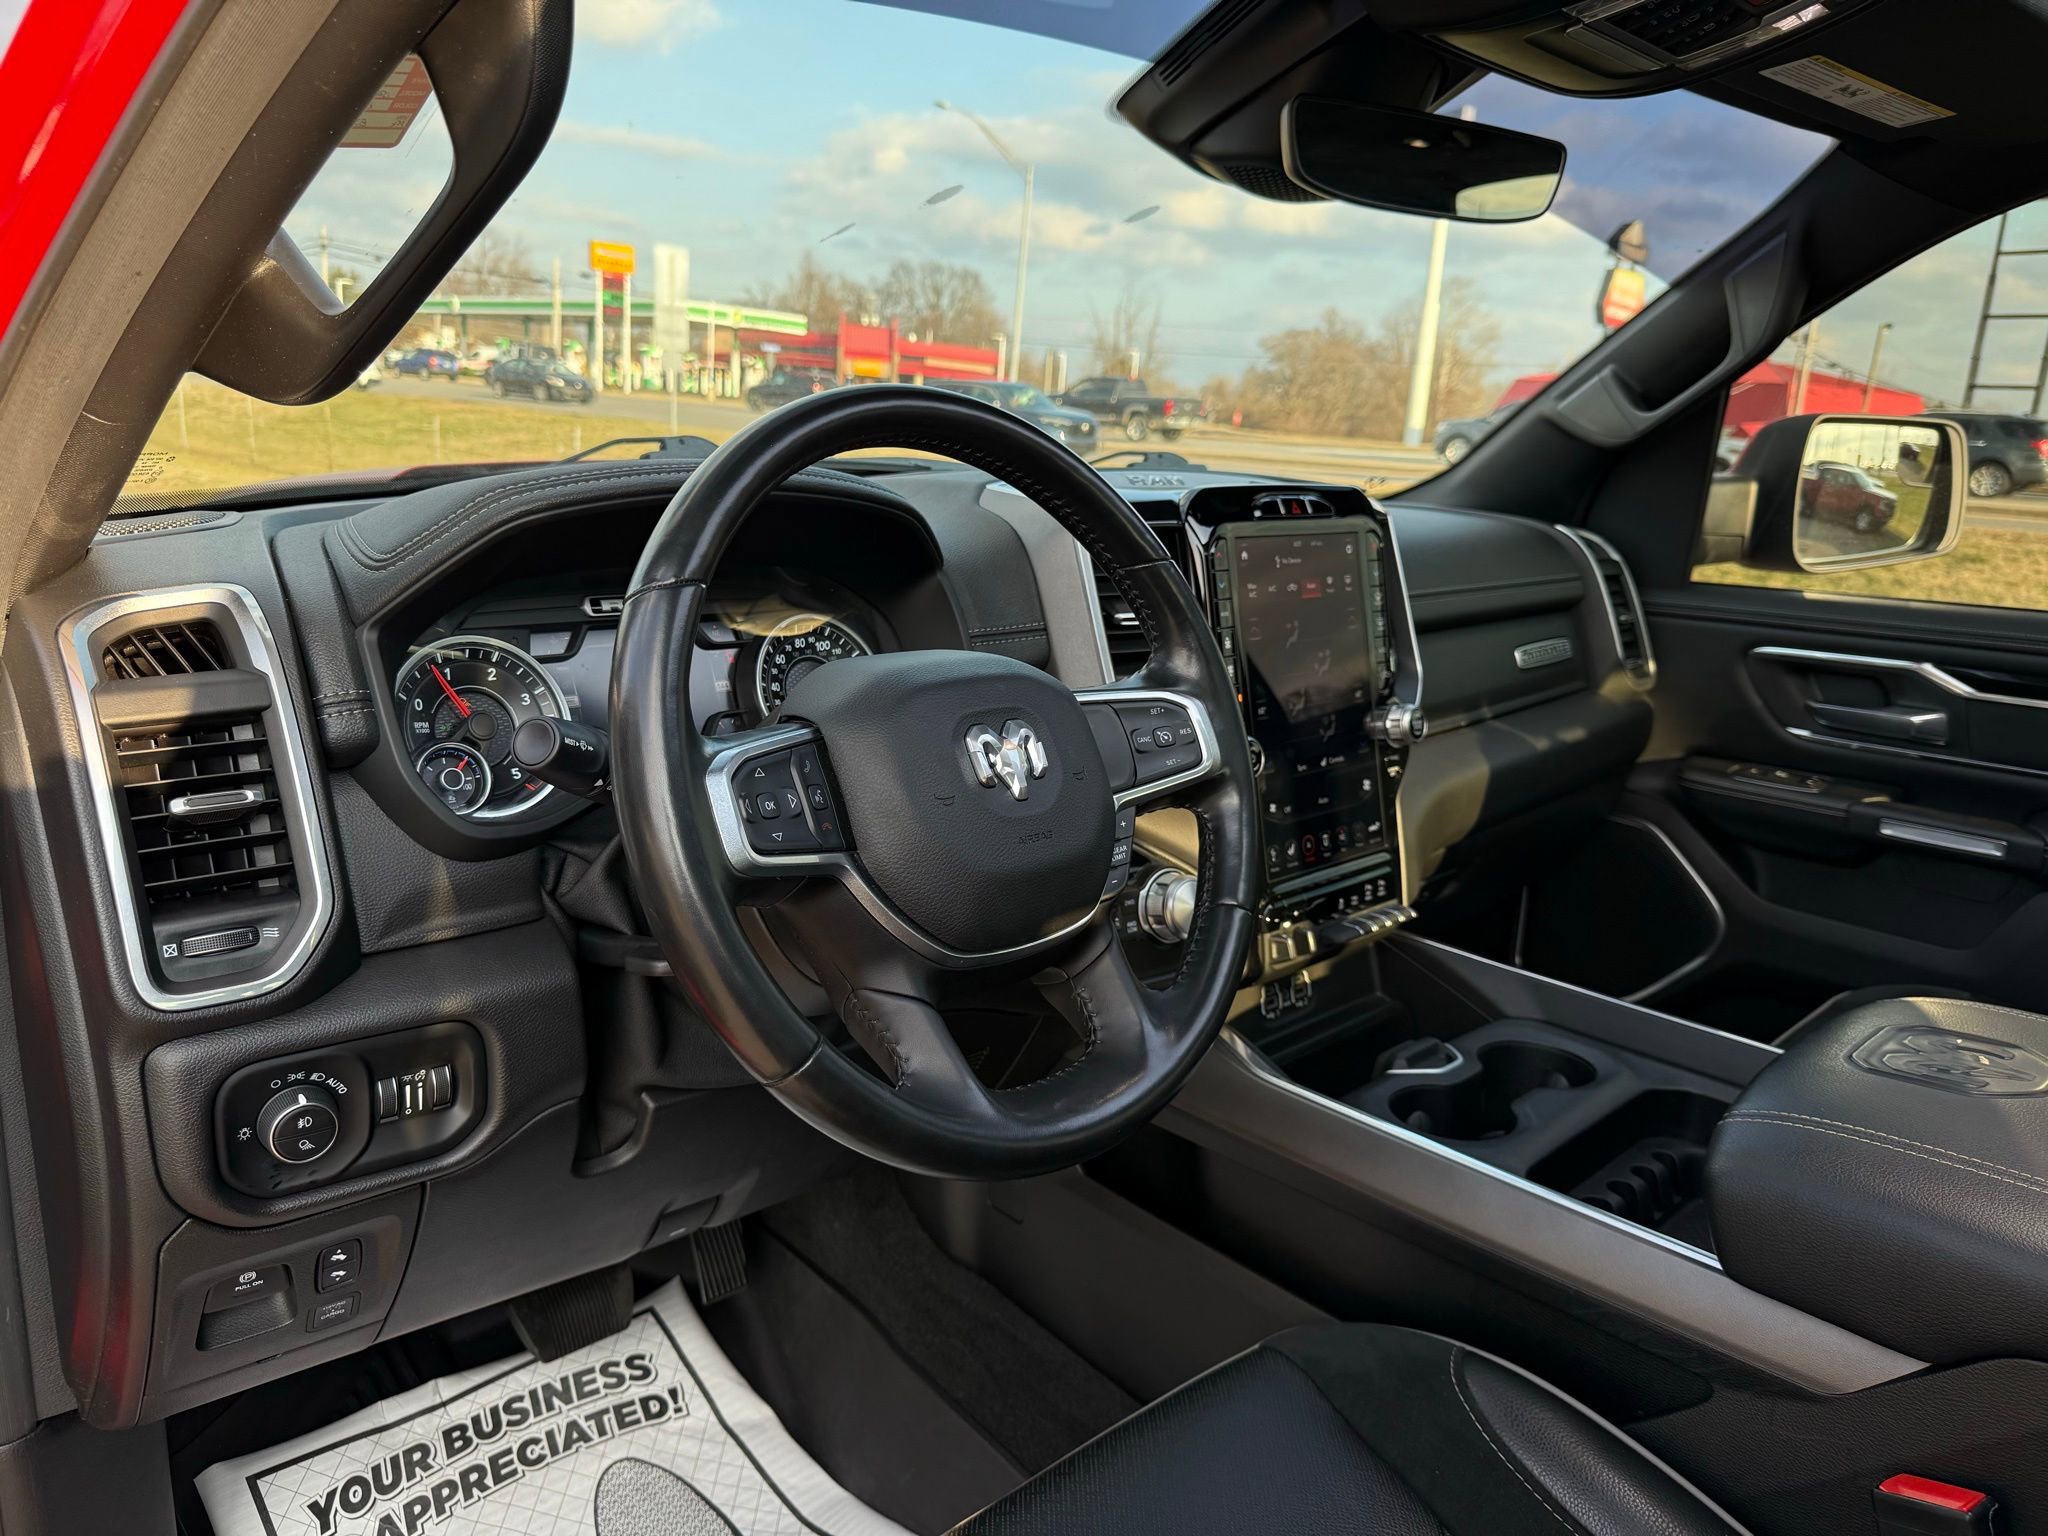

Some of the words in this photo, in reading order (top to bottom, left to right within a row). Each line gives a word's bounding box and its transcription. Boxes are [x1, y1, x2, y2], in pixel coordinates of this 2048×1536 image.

[794, 638, 806, 648] 80
[815, 640, 831, 651] 100
[775, 654, 786, 664] 60
[443, 667, 451, 681] 1
[487, 667, 497, 681] 2
[771, 682, 780, 692] 40
[414, 698, 423, 711] 0
[520, 693, 531, 706] 3
[414, 721, 430, 729] RPM
[1179, 727, 1192, 735] RES
[510, 767, 522, 780] 5
[764, 800, 777, 811] OK
[325, 1077, 348, 1094] AUTO
[234, 1283, 252, 1292] PULL
[252, 1279, 264, 1287] ON
[304, 1440, 438, 1535] YOUR
[440, 1351, 656, 1461] BUSINESS
[374, 1384, 687, 1536] APPRECIATED!
